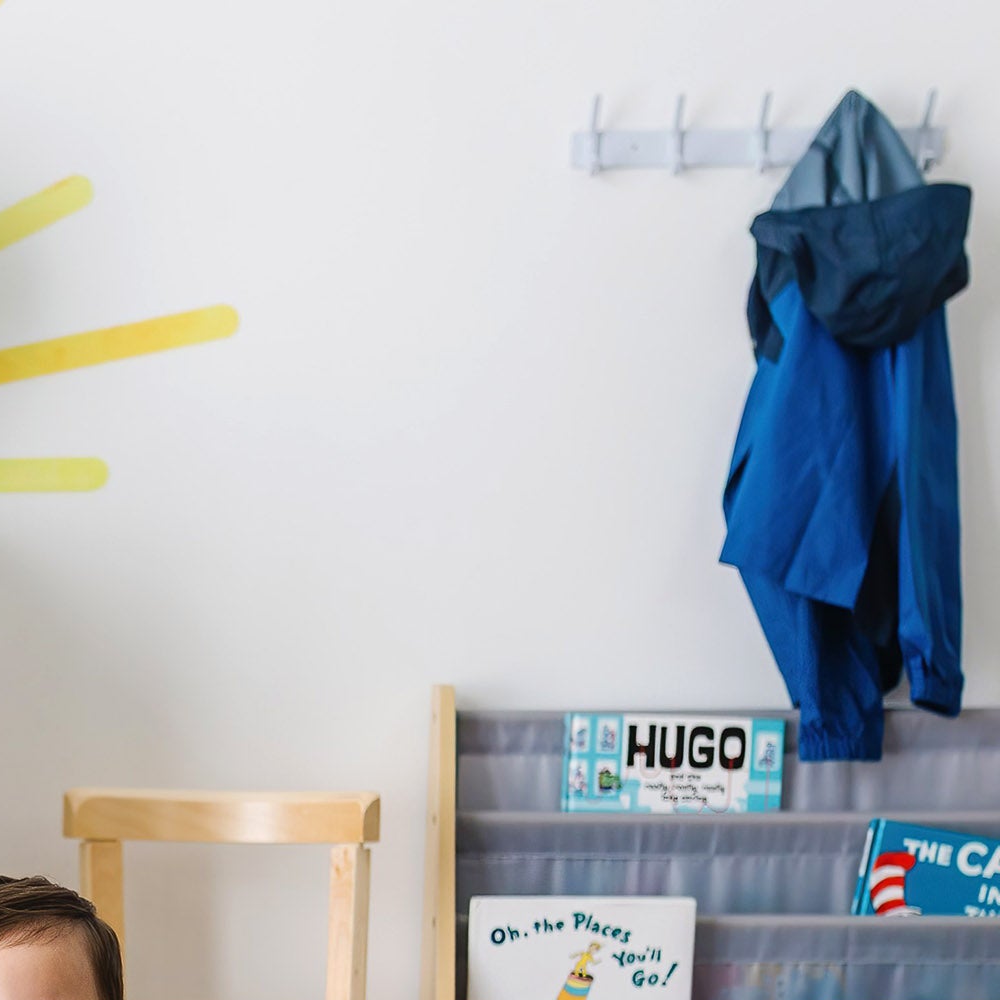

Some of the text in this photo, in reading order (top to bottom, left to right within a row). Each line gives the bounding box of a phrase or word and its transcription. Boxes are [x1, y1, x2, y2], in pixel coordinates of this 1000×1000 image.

[627, 725, 746, 769] HUGO
[903, 837, 954, 867] THE
[533, 919, 565, 934] the
[573, 912, 633, 944] Places
[611, 947, 662, 967] You'll
[631, 962, 678, 987] Go!
